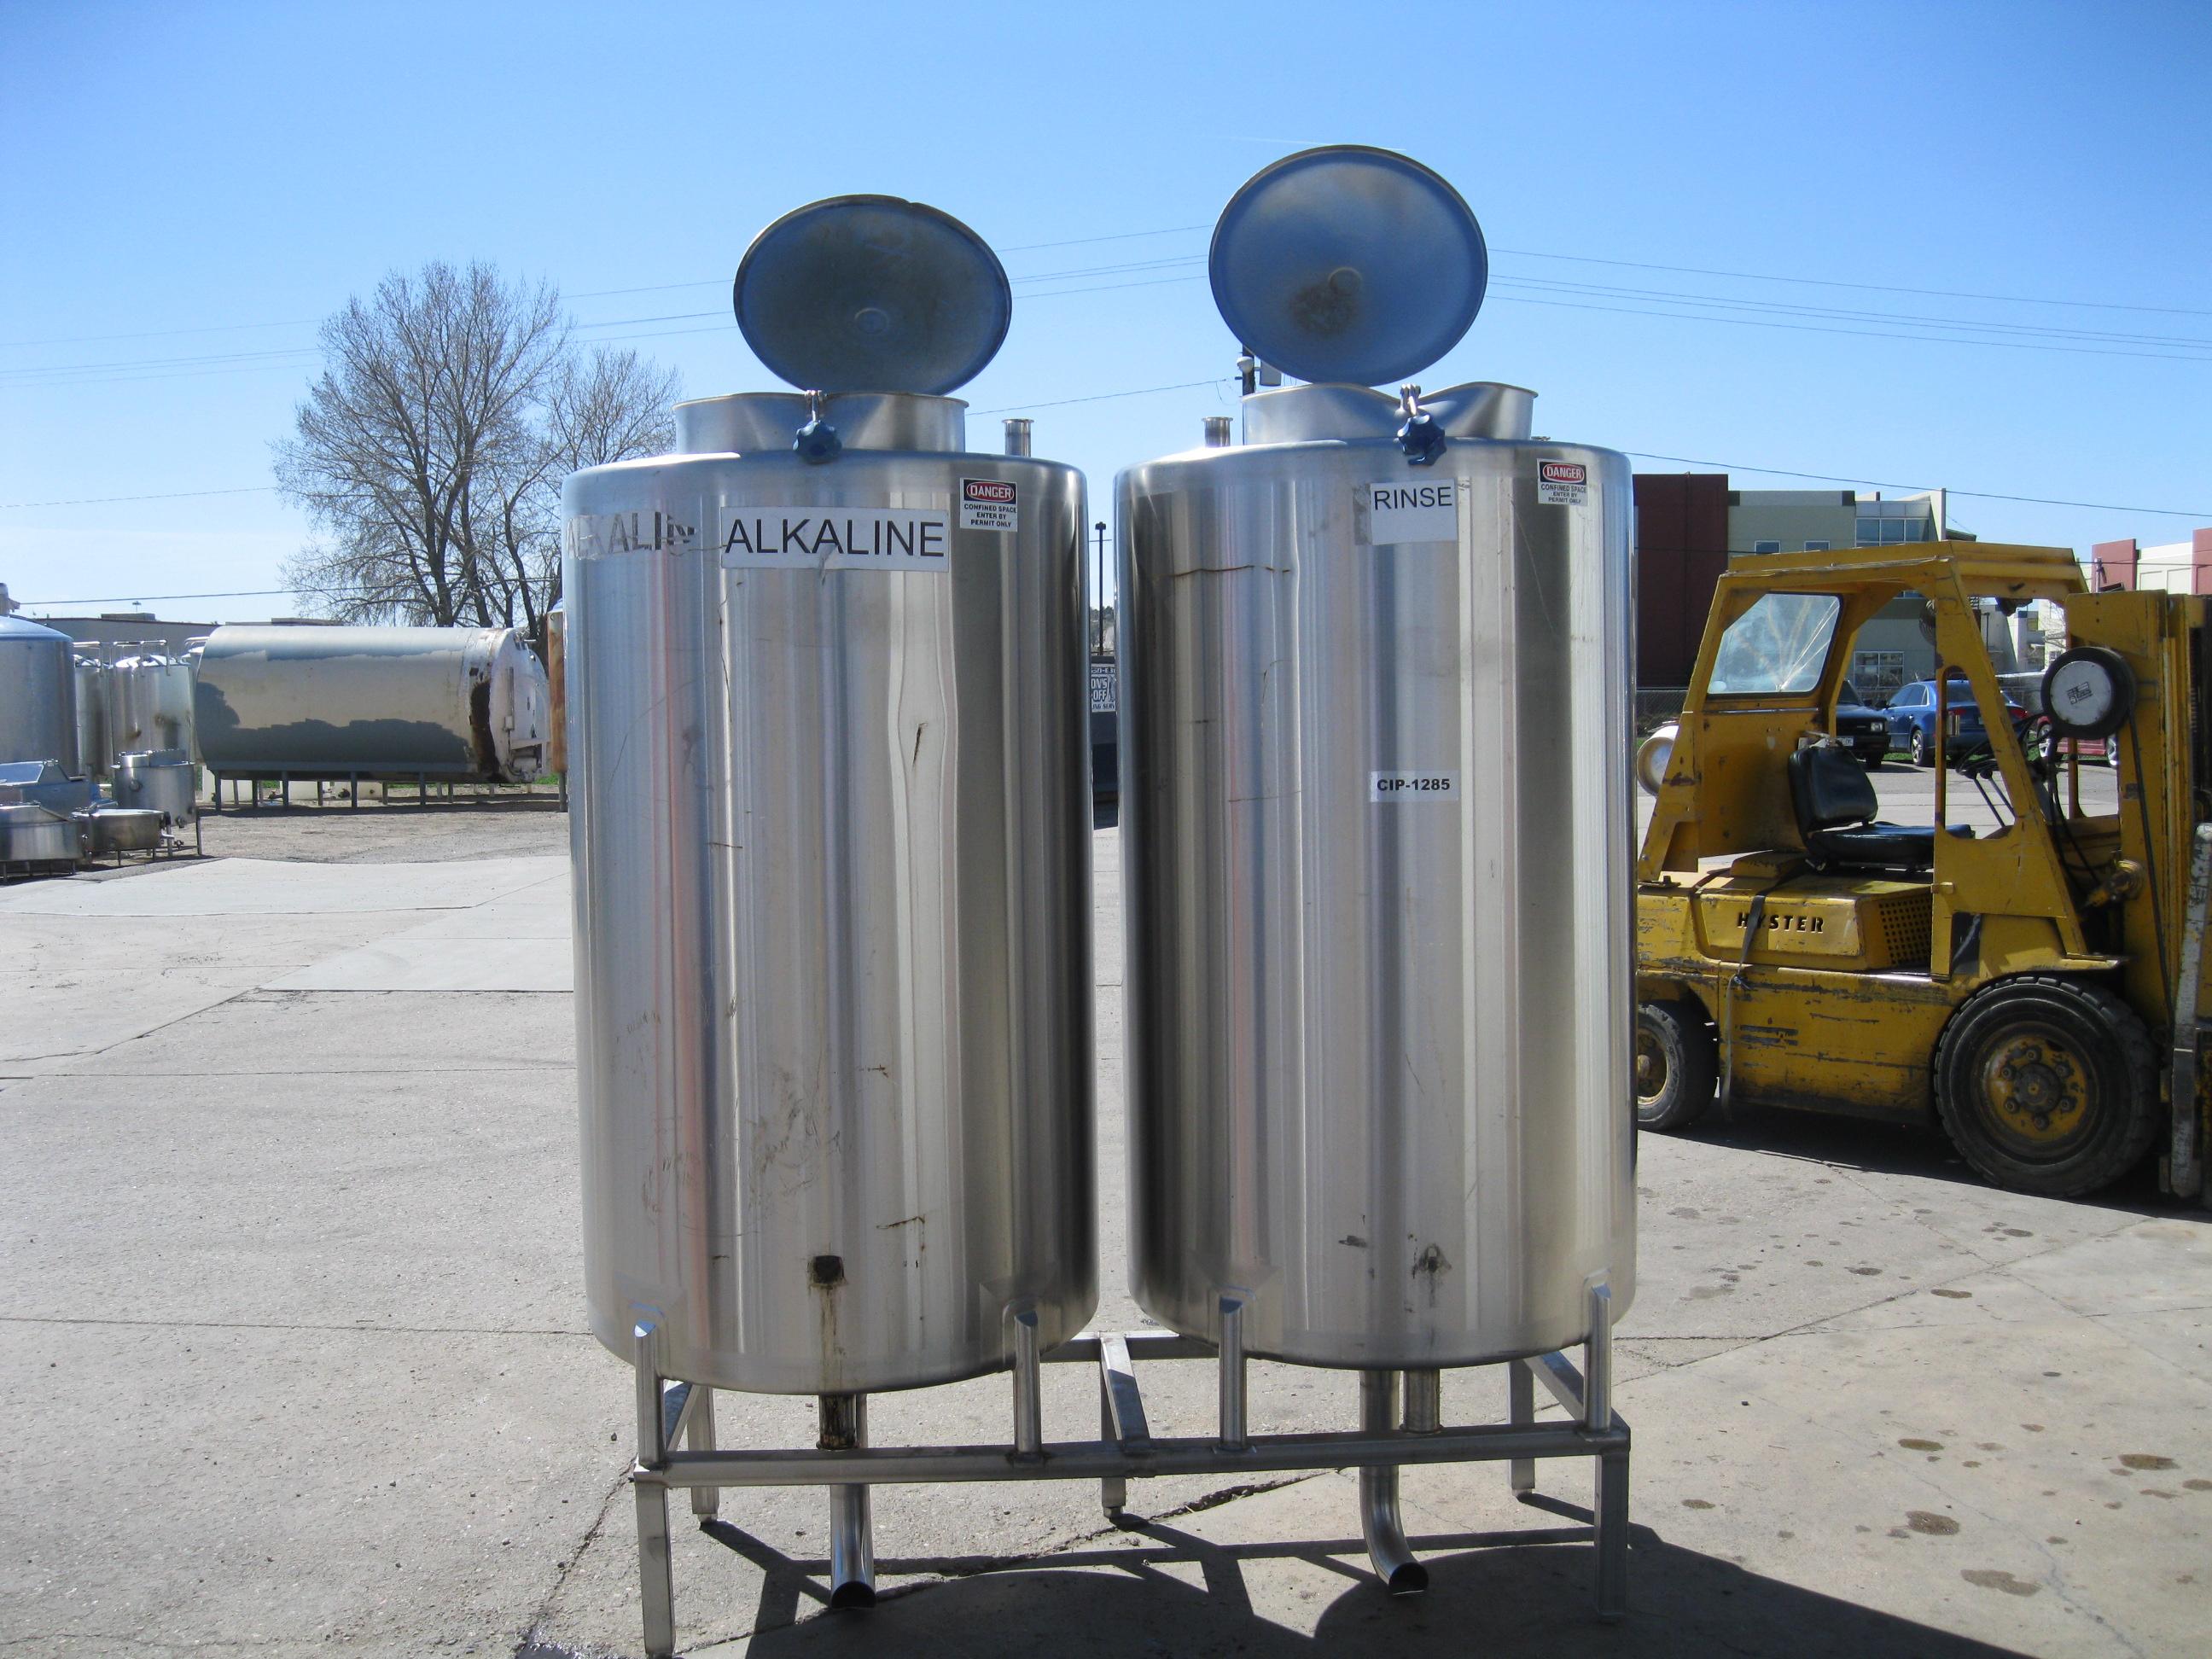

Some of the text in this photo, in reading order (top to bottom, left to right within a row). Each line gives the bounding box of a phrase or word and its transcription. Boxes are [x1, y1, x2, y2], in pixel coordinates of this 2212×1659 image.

[1546, 466, 1582, 479] DANGER
[969, 485, 1011, 498] DANGER
[1540, 483, 1569, 492] CONFINED
[1374, 486, 1452, 510] RINSE
[998, 505, 1016, 514] SPACE
[725, 519, 945, 557] ALKALINE
[1377, 778, 1451, 791] CIP-1285
